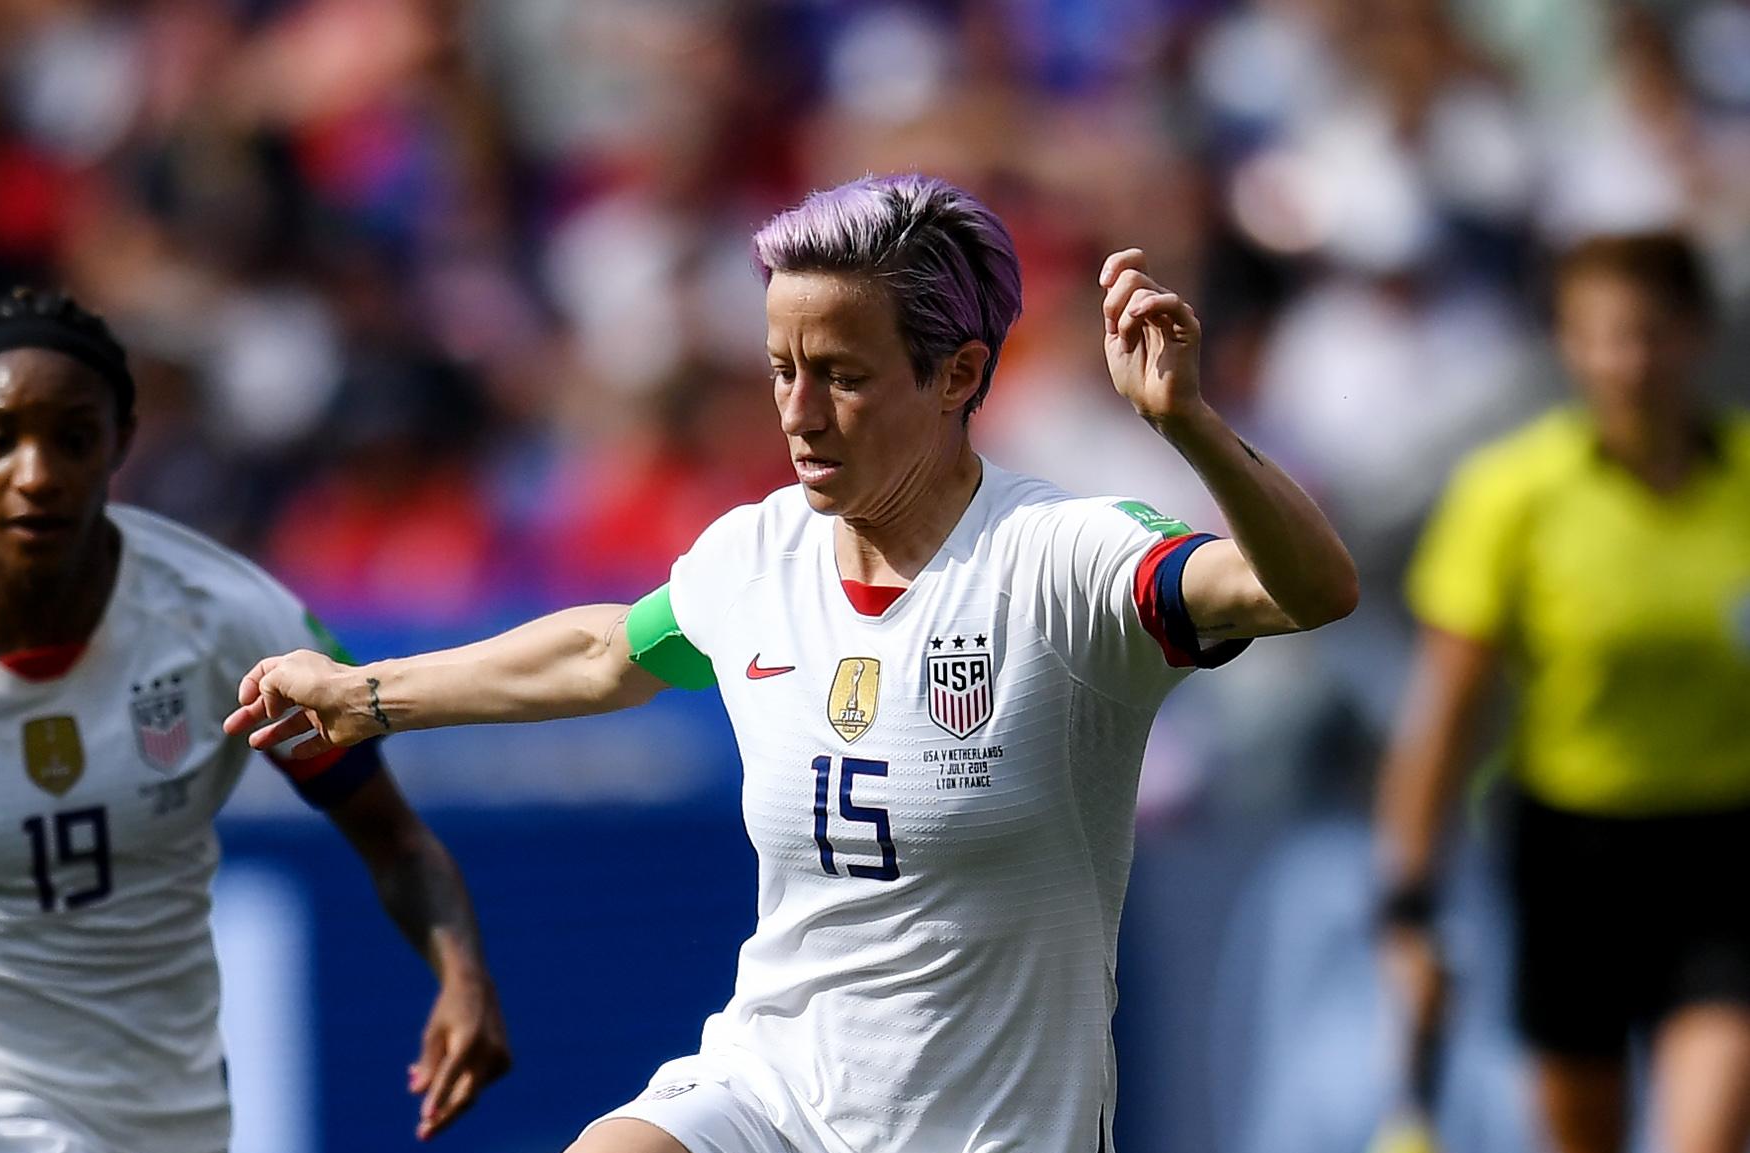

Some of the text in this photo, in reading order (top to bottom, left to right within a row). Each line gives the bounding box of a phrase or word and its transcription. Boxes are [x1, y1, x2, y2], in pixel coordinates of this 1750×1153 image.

[933, 661, 985, 692] USA
[923, 745, 1004, 762] USA V NETHERLANDS
[939, 761, 988, 775] 7 JULY 2019
[936, 775, 992, 790] LYON FRANCE
[810, 755, 901, 882] 15
[21, 806, 113, 913] 19
